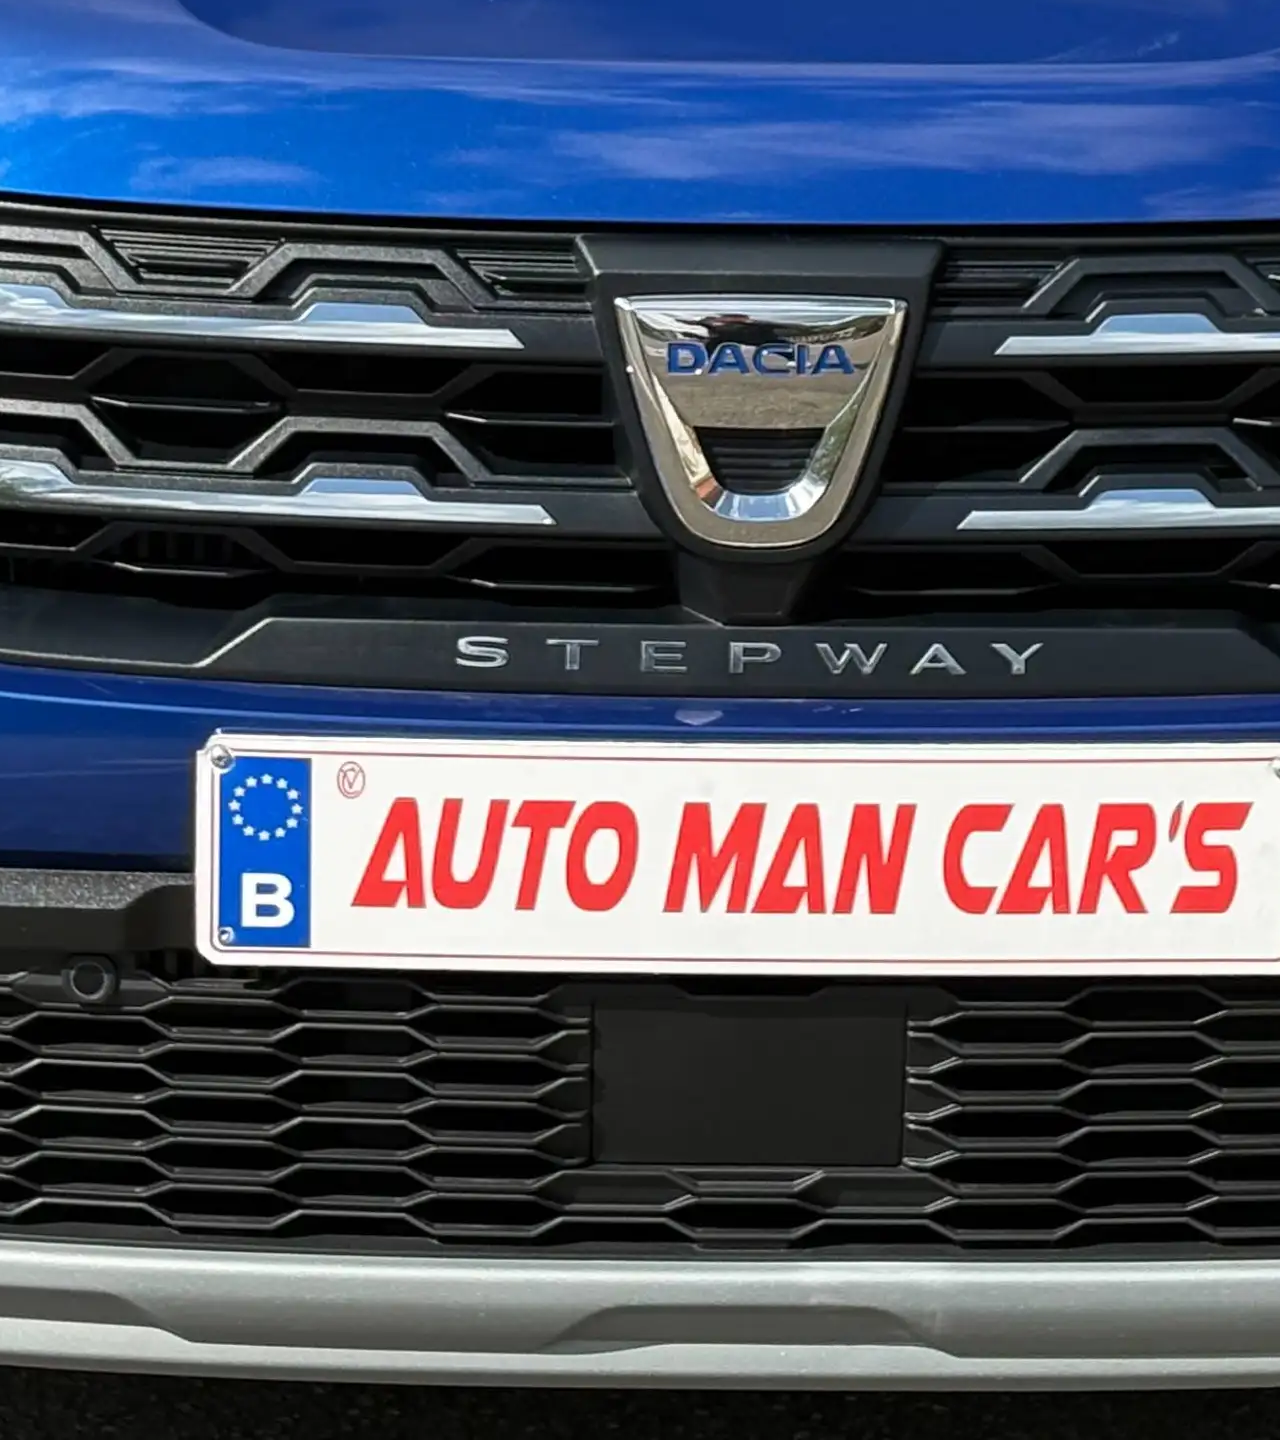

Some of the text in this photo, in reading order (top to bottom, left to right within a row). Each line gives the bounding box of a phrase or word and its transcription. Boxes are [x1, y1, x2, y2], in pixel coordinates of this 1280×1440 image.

[666, 341, 856, 376] DACIA
[455, 636, 1045, 676] STEPWAY
[350, 796, 1254, 914] AUTO MAN CAR'S
[240, 871, 296, 929] B
